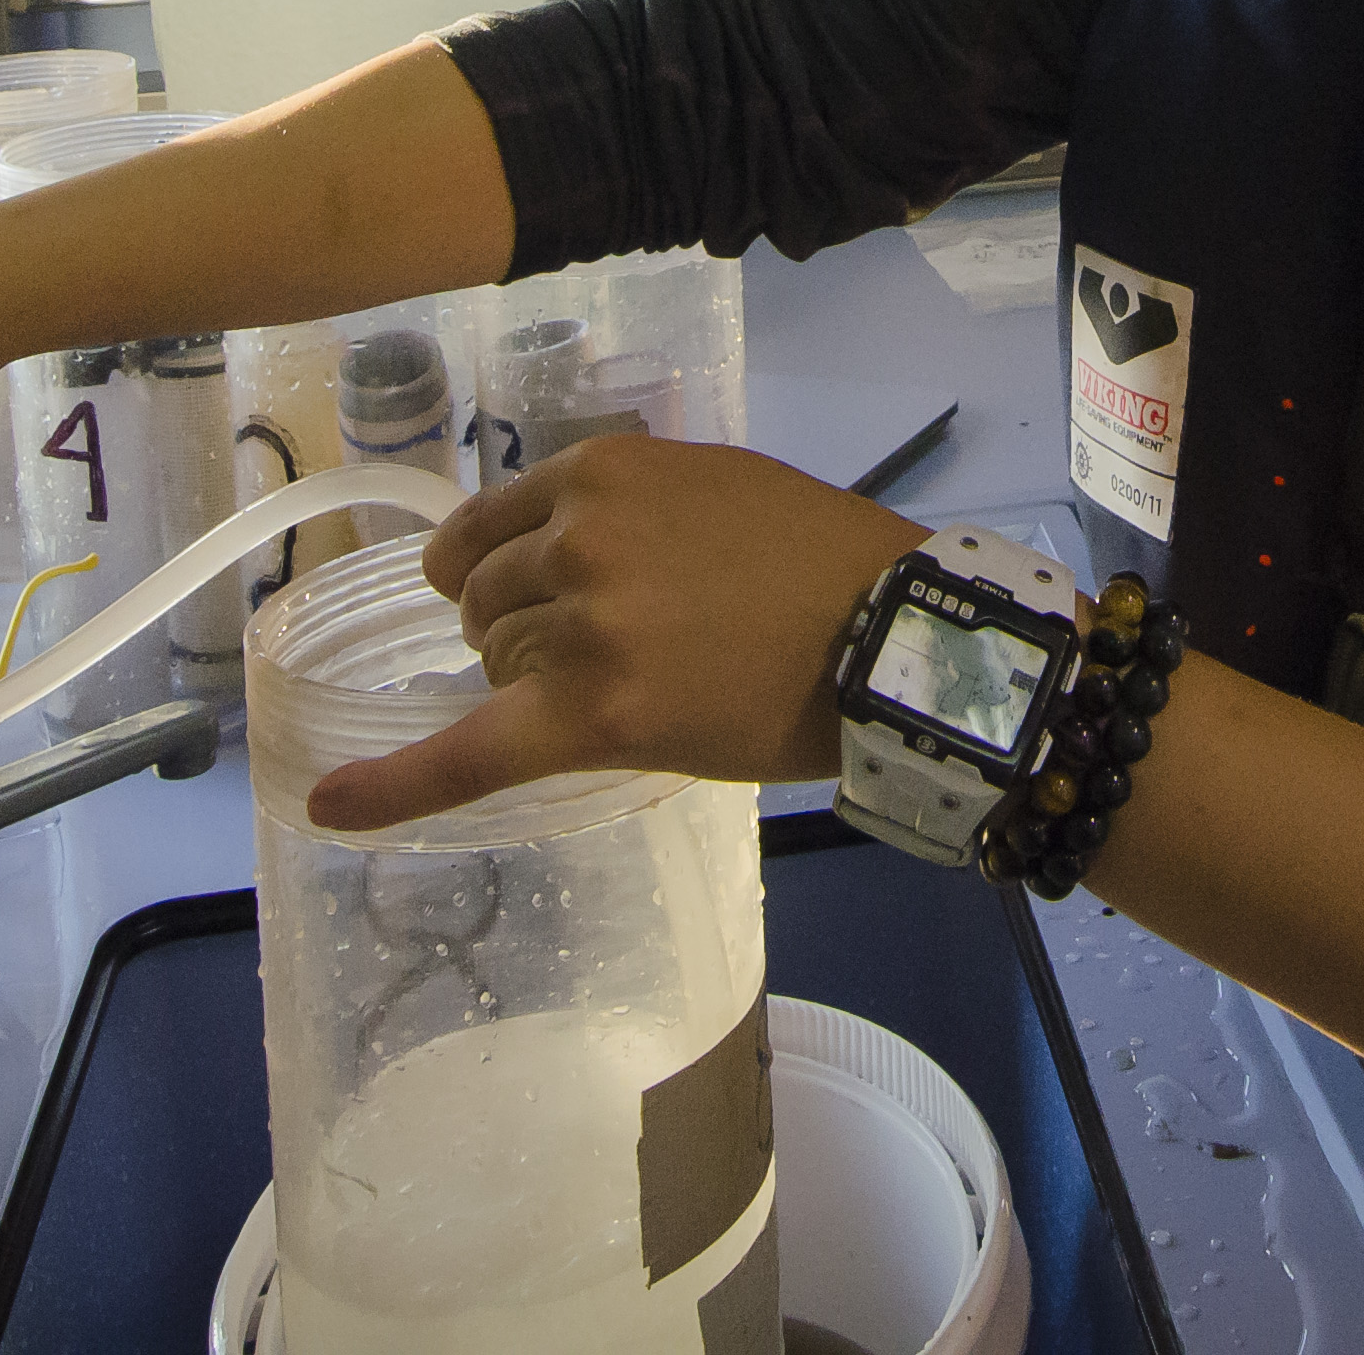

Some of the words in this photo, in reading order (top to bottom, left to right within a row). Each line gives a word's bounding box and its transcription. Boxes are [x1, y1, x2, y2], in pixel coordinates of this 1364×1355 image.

[1078, 358, 1170, 436] VIKING
[41, 400, 109, 522] 4
[1113, 422, 1165, 454] EQUIPMENT
[1110, 474, 1162, 517] 0200/11
